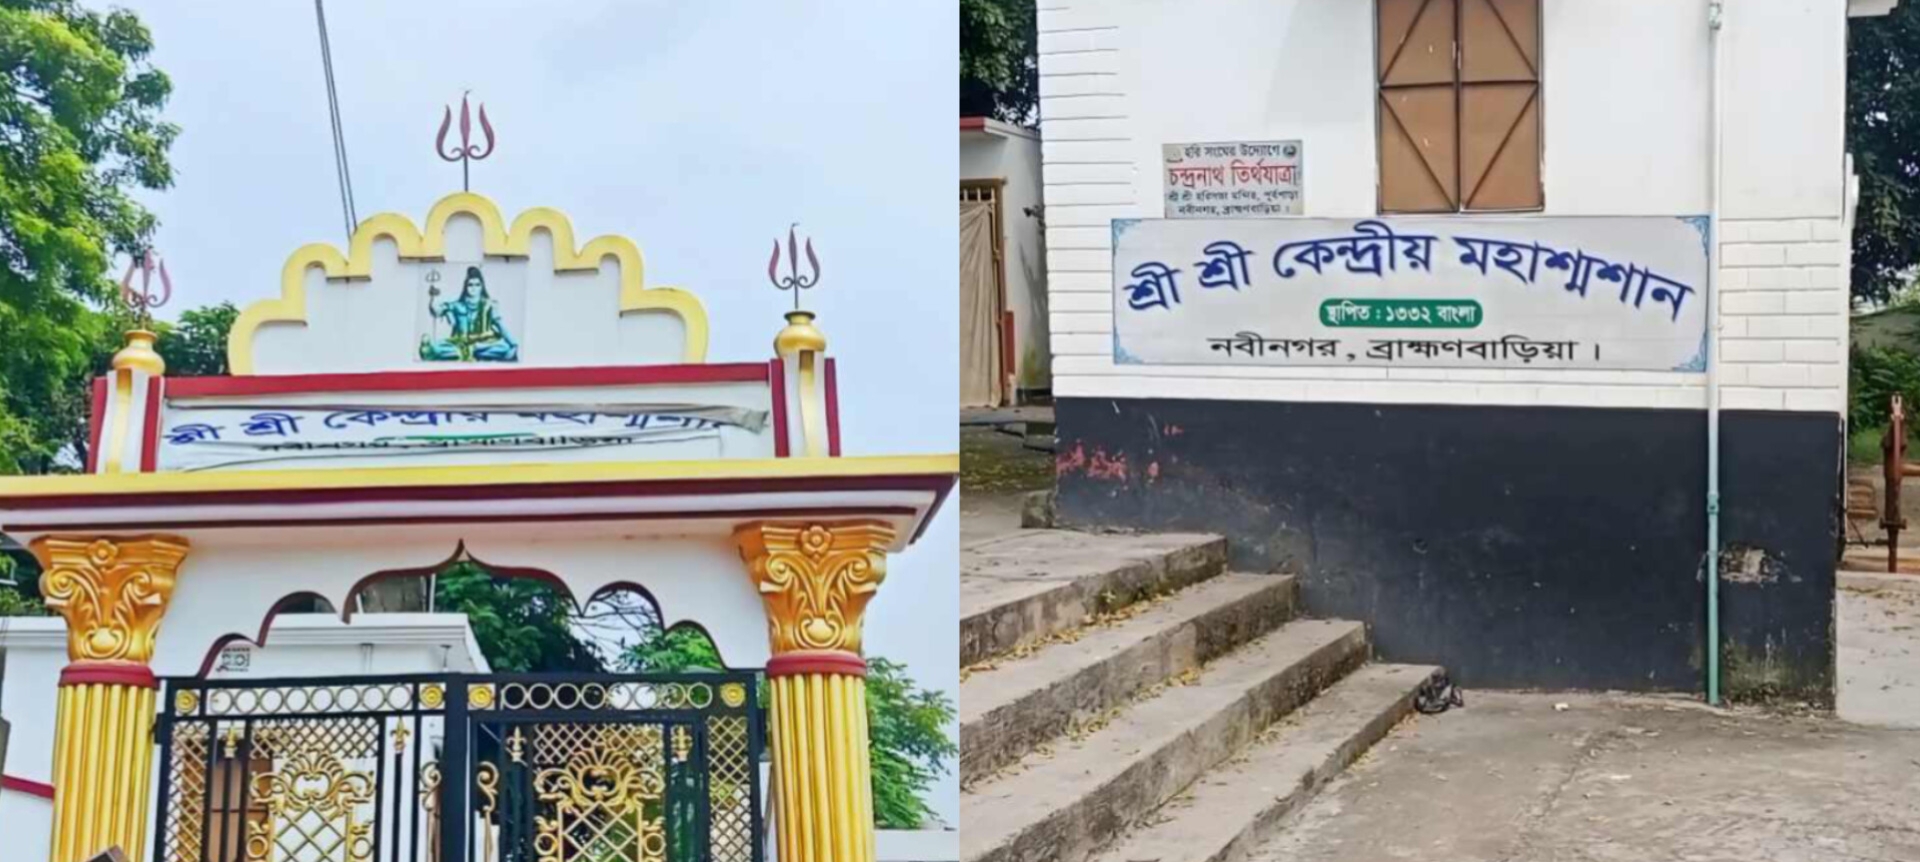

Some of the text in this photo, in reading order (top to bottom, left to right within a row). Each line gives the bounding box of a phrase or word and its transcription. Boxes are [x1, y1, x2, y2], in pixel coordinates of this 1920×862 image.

[1168, 158, 1298, 188] চন্দ্রনাথ তির্থযাত্রা
[1123, 220, 1697, 323] শ্রী শ্রী কেন্দ্রীয় মহাশ্মশান
[1325, 300, 1372, 325] স্থাপিত
[1385, 305, 1432, 323] ১৩৩২
[1436, 304, 1477, 323] বাংলা
[1366, 333, 1580, 364] ব্রাহ্মণবাড়িয়া
[239, 412, 305, 437] শ্রী
